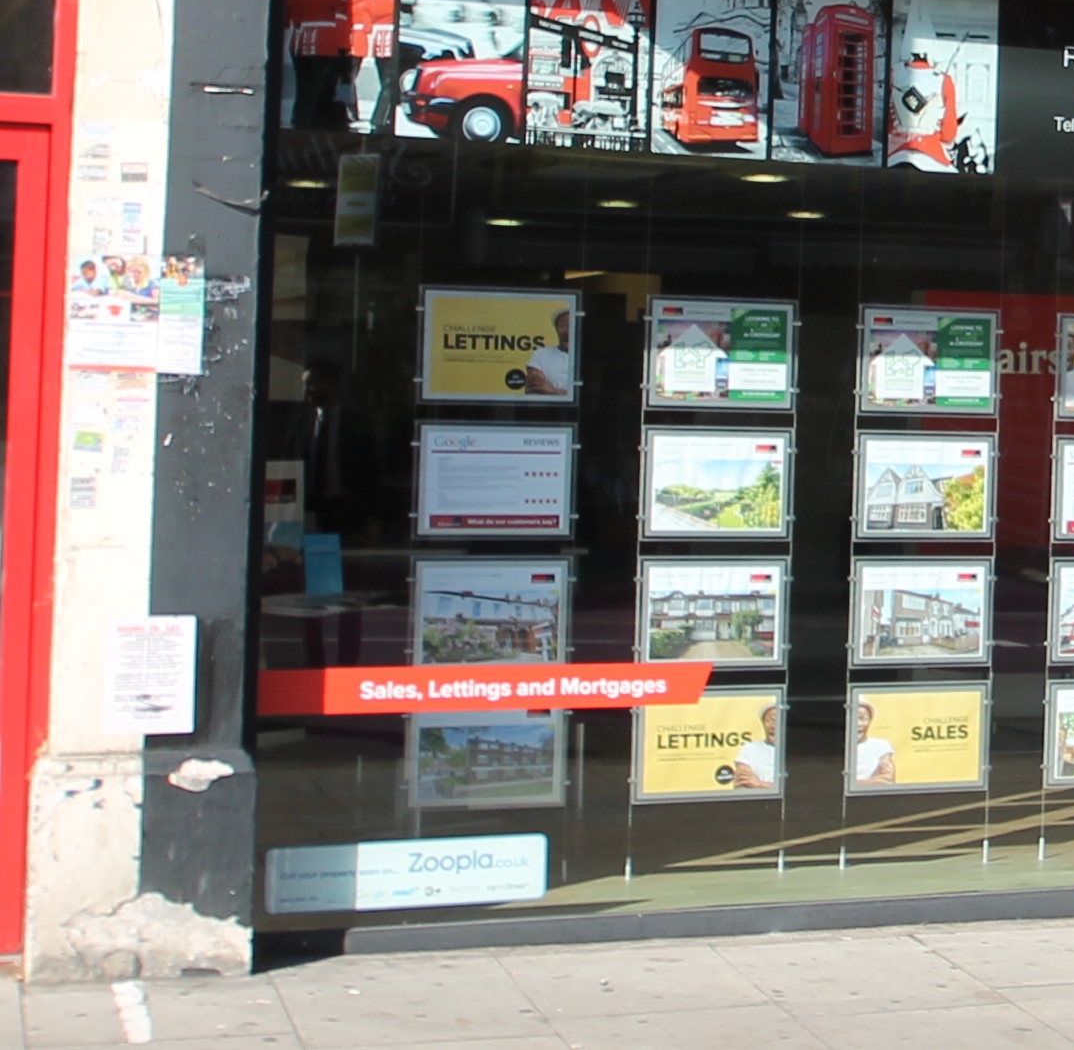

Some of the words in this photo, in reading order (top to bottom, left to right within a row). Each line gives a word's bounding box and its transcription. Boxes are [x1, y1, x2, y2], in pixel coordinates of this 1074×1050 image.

[443, 334, 545, 351] LETTINGS
[434, 435, 476, 450] Google
[523, 438, 560, 447] REVIEWS
[467, 517, 484, 525] What
[359, 680, 423, 701] Sales,
[428, 678, 511, 701] Lettings
[516, 678, 555, 697] and
[560, 677, 667, 699] Mortgages
[657, 732, 752, 749] LETTINGS
[911, 724, 969, 741] SALES
